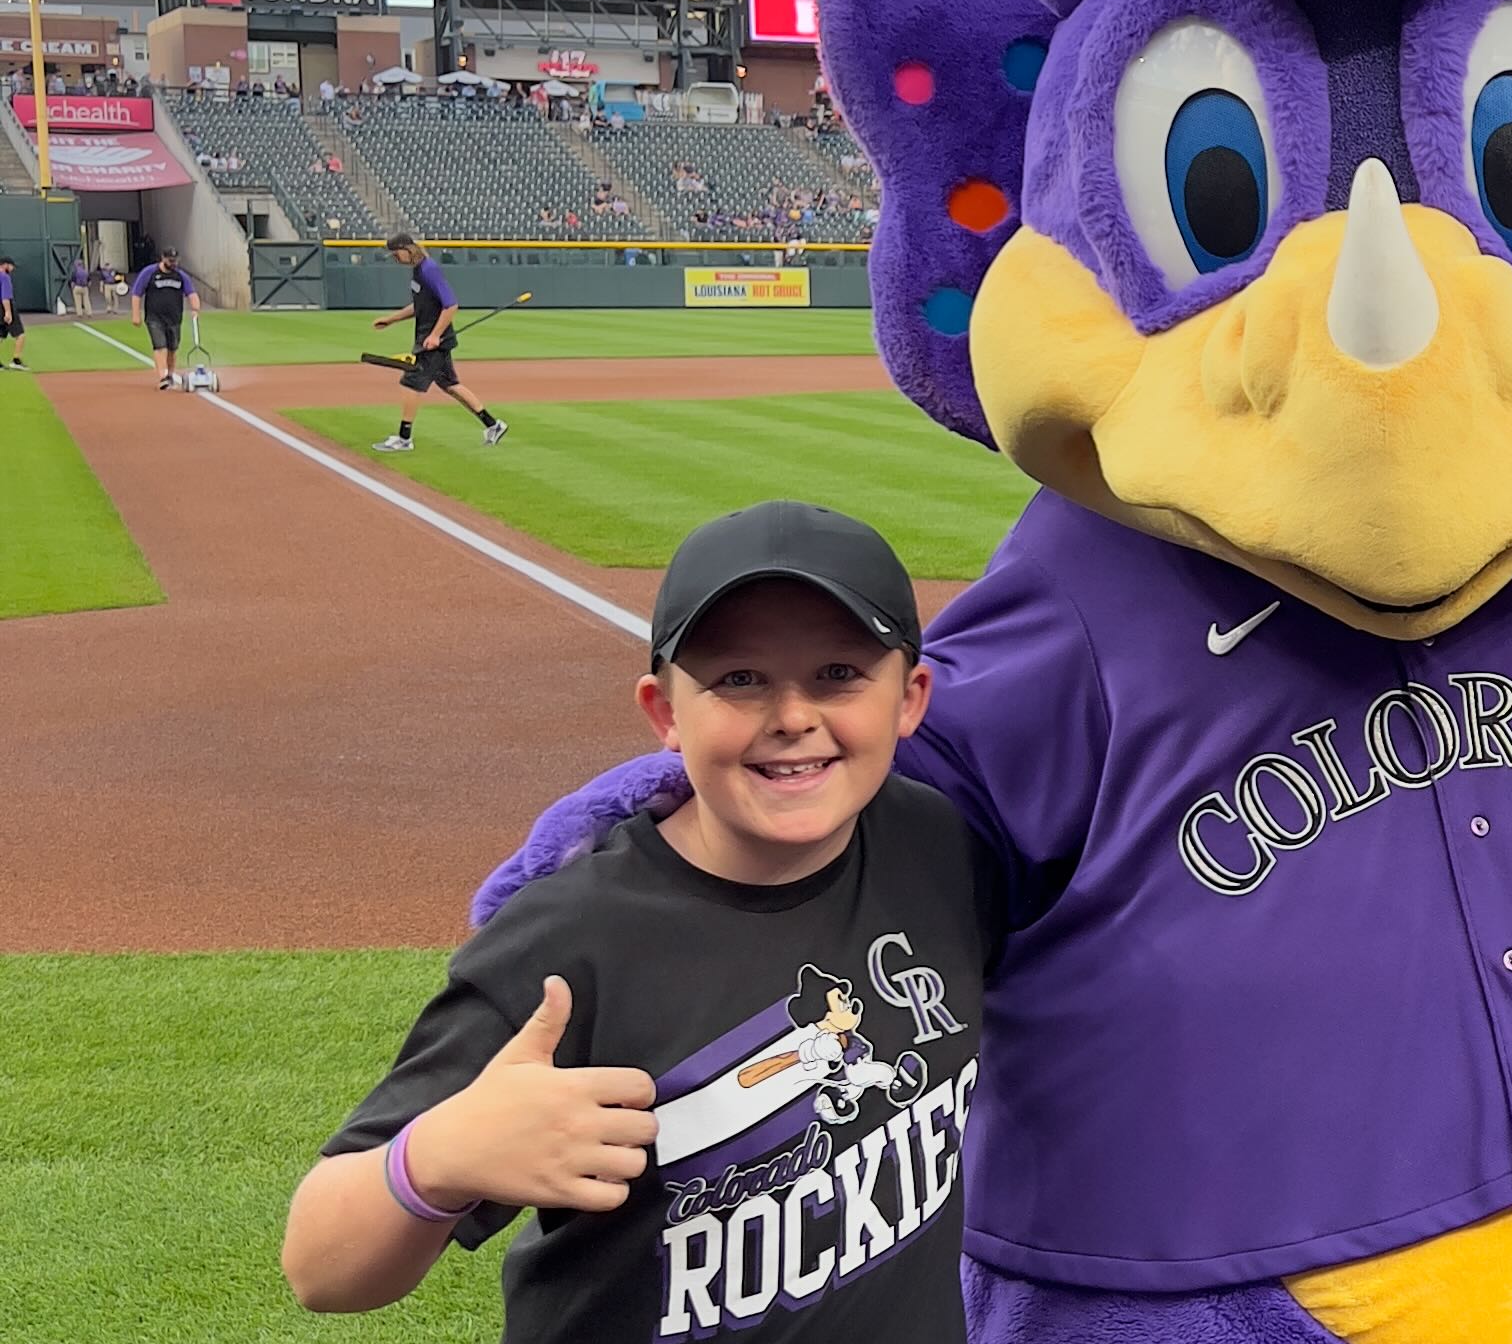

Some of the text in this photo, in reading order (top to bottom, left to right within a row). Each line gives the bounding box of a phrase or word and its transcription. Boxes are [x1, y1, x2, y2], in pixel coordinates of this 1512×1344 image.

[47, 100, 131, 123] chealth
[79, 162, 166, 174] CHARITY
[694, 285, 747, 296] LOUISIANA
[665, 1121, 833, 1224] Colorado
